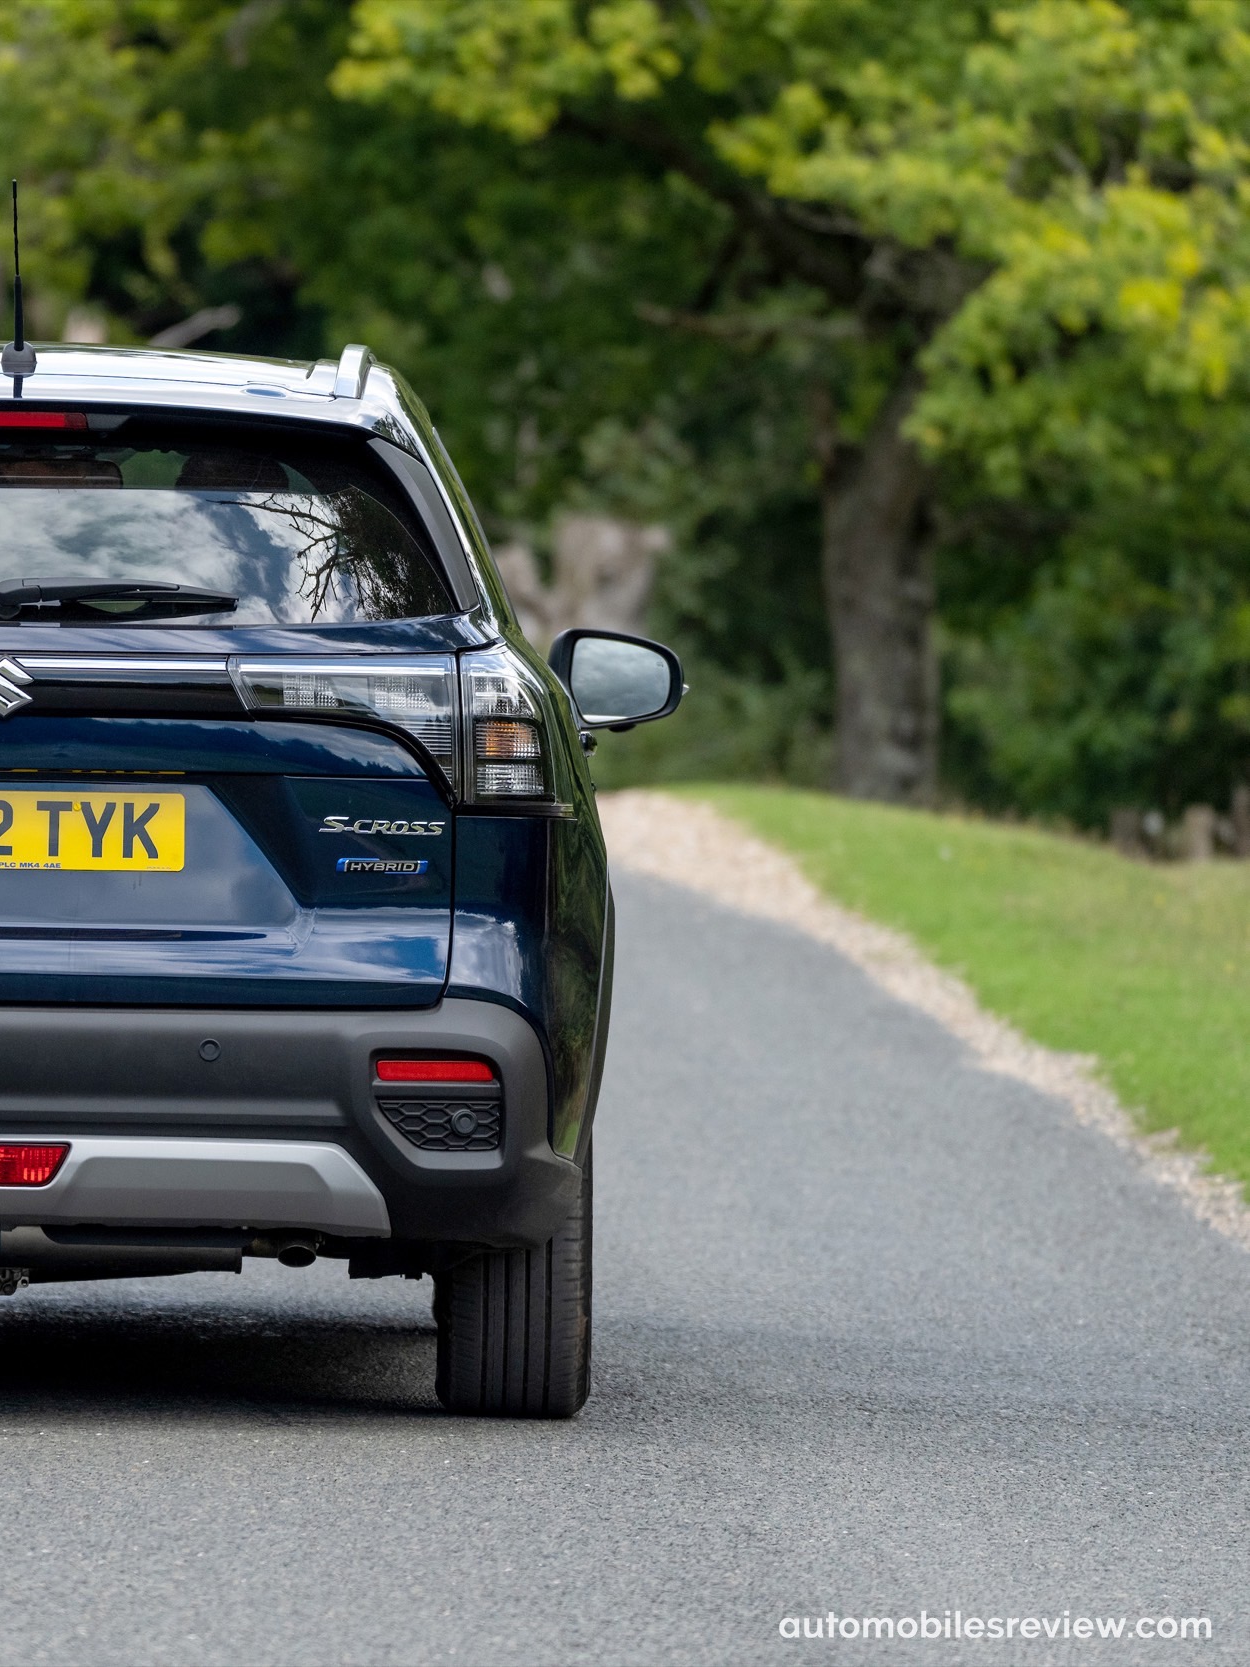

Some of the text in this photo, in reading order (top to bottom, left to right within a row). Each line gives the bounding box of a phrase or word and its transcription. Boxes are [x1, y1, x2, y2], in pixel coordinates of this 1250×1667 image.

[36, 800, 161, 859] TYK
[318, 816, 446, 835] S-CROSS
[350, 862, 415, 872] HYBRID
